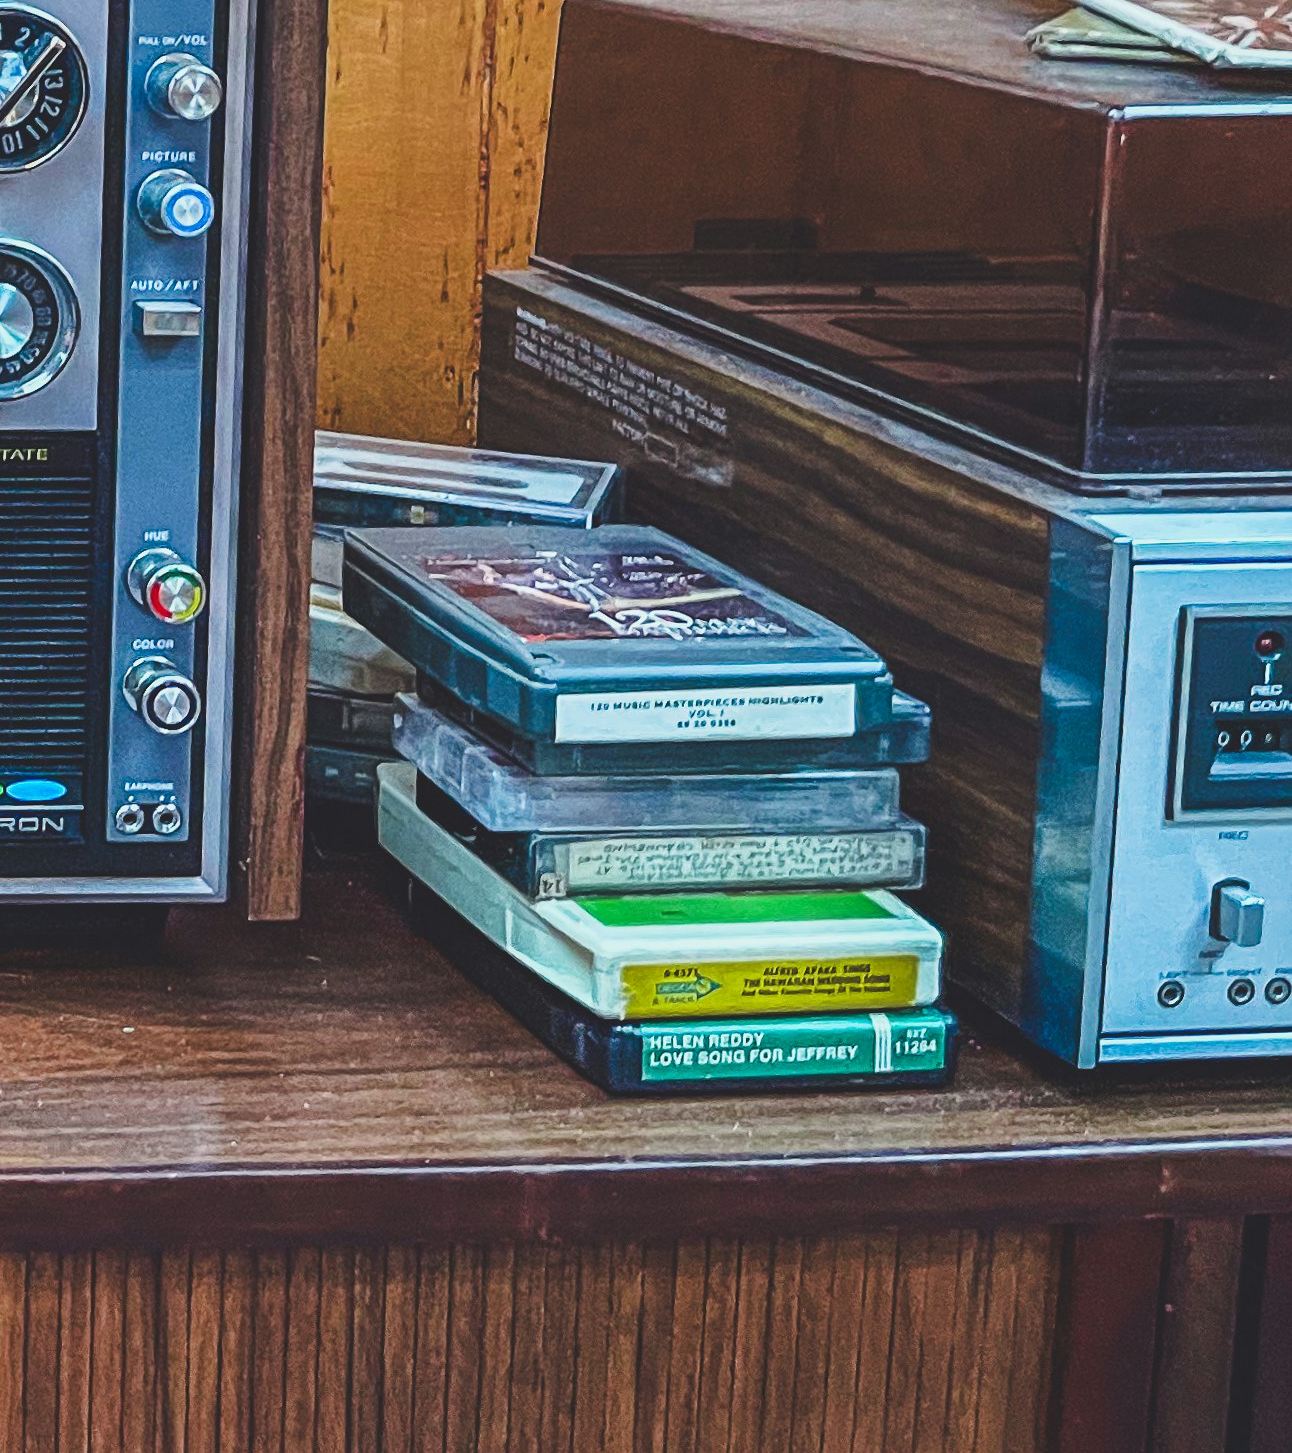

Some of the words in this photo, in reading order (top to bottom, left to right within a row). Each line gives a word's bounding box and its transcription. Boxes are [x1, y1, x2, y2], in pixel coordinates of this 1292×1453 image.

[141, 150, 196, 162] PICTURE
[130, 279, 200, 292] AUTO/AFT
[144, 530, 169, 541] HUE
[132, 638, 174, 650] COLOR
[1250, 684, 1283, 696] REC
[613, 701, 651, 710] MUSIC
[654, 697, 746, 709] MASTERPIECES
[748, 695, 824, 706] HIGHLIGHTS
[1210, 700, 1245, 714] TIME
[649, 1034, 704, 1049] HELEN
[708, 1032, 765, 1048] REDDY
[649, 1051, 692, 1067] LOVE
[697, 1049, 745, 1065] SONG
[749, 1048, 783, 1063] FOR
[787, 1045, 859, 1063] JEFFREY
